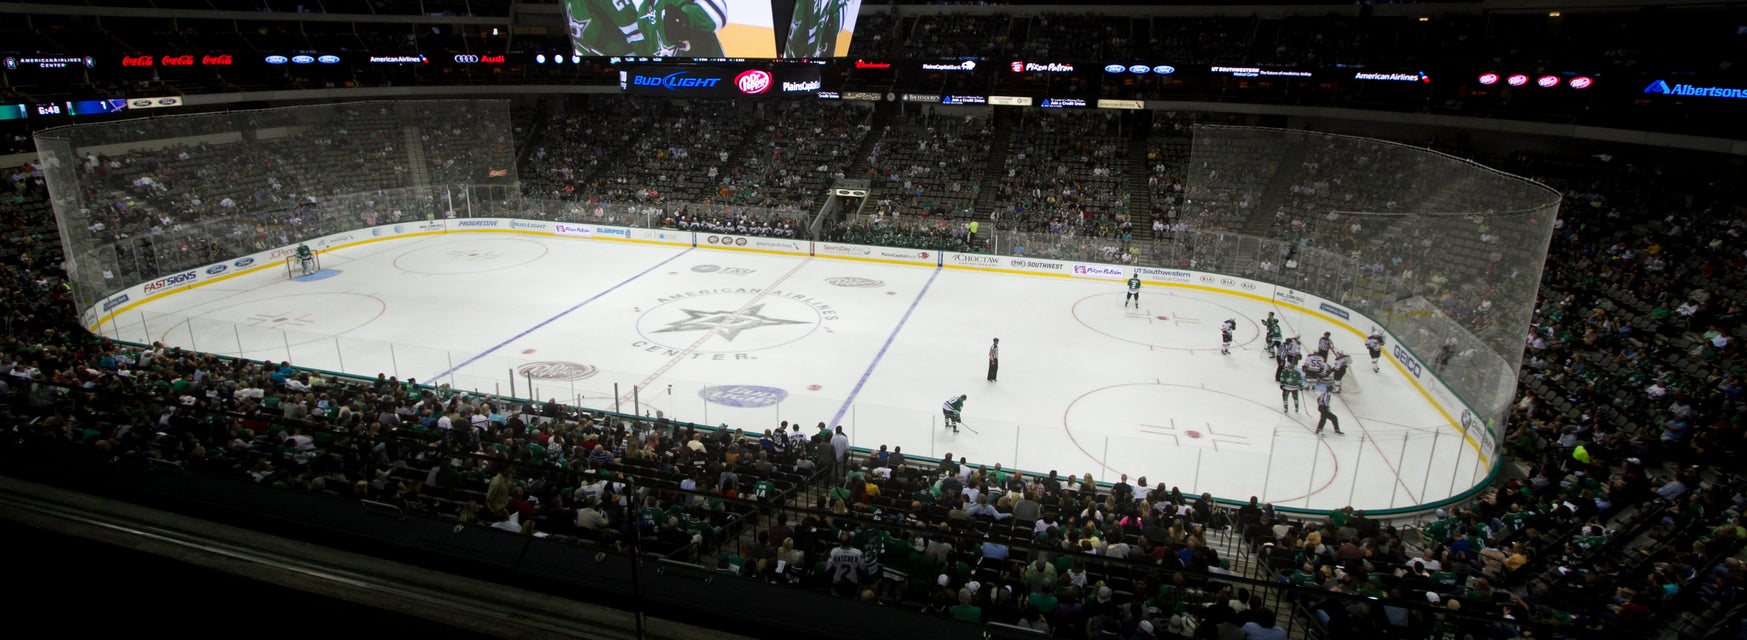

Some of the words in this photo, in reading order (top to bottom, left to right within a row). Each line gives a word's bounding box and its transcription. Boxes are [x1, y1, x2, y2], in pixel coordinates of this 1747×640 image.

[481, 55, 505, 63] Audi
[634, 75, 662, 86] BUD
[669, 77, 721, 88] LIGHT
[1670, 83, 1747, 99] Albertsons
[38, 105, 61, 115] 6:48
[956, 254, 999, 264] CHOCTAW
[1027, 262, 1063, 270] SOUTHWEST
[1144, 268, 1191, 278] Southwestern
[143, 270, 198, 293] FASTSIGNS
[657, 287, 764, 303] AMERICAN
[774, 289, 840, 322] AIRLINES
[632, 340, 749, 360] CENTER
[1394, 343, 1422, 379] GEICO
